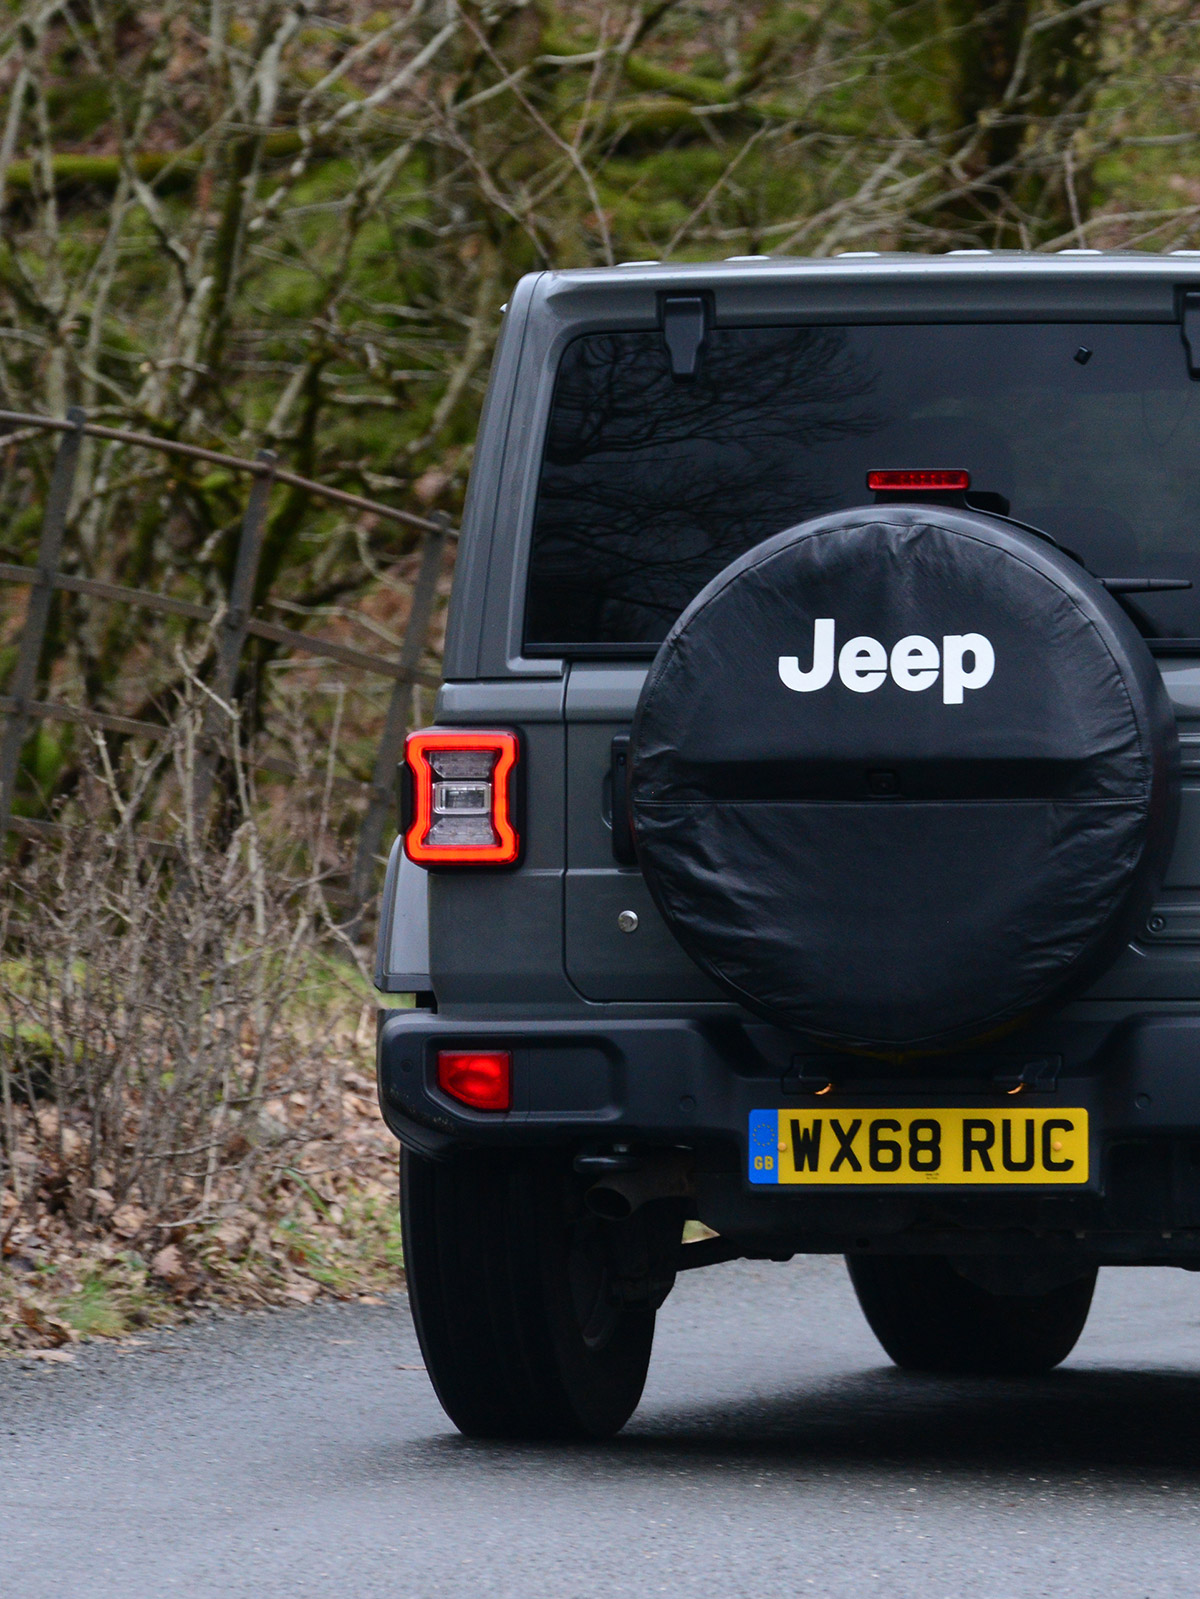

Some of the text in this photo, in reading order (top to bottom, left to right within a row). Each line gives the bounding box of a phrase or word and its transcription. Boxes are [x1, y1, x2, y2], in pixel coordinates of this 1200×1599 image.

[778, 618, 995, 705] Jeep
[754, 1155, 774, 1170] GB
[790, 1118, 1075, 1173] WX68 RUC
